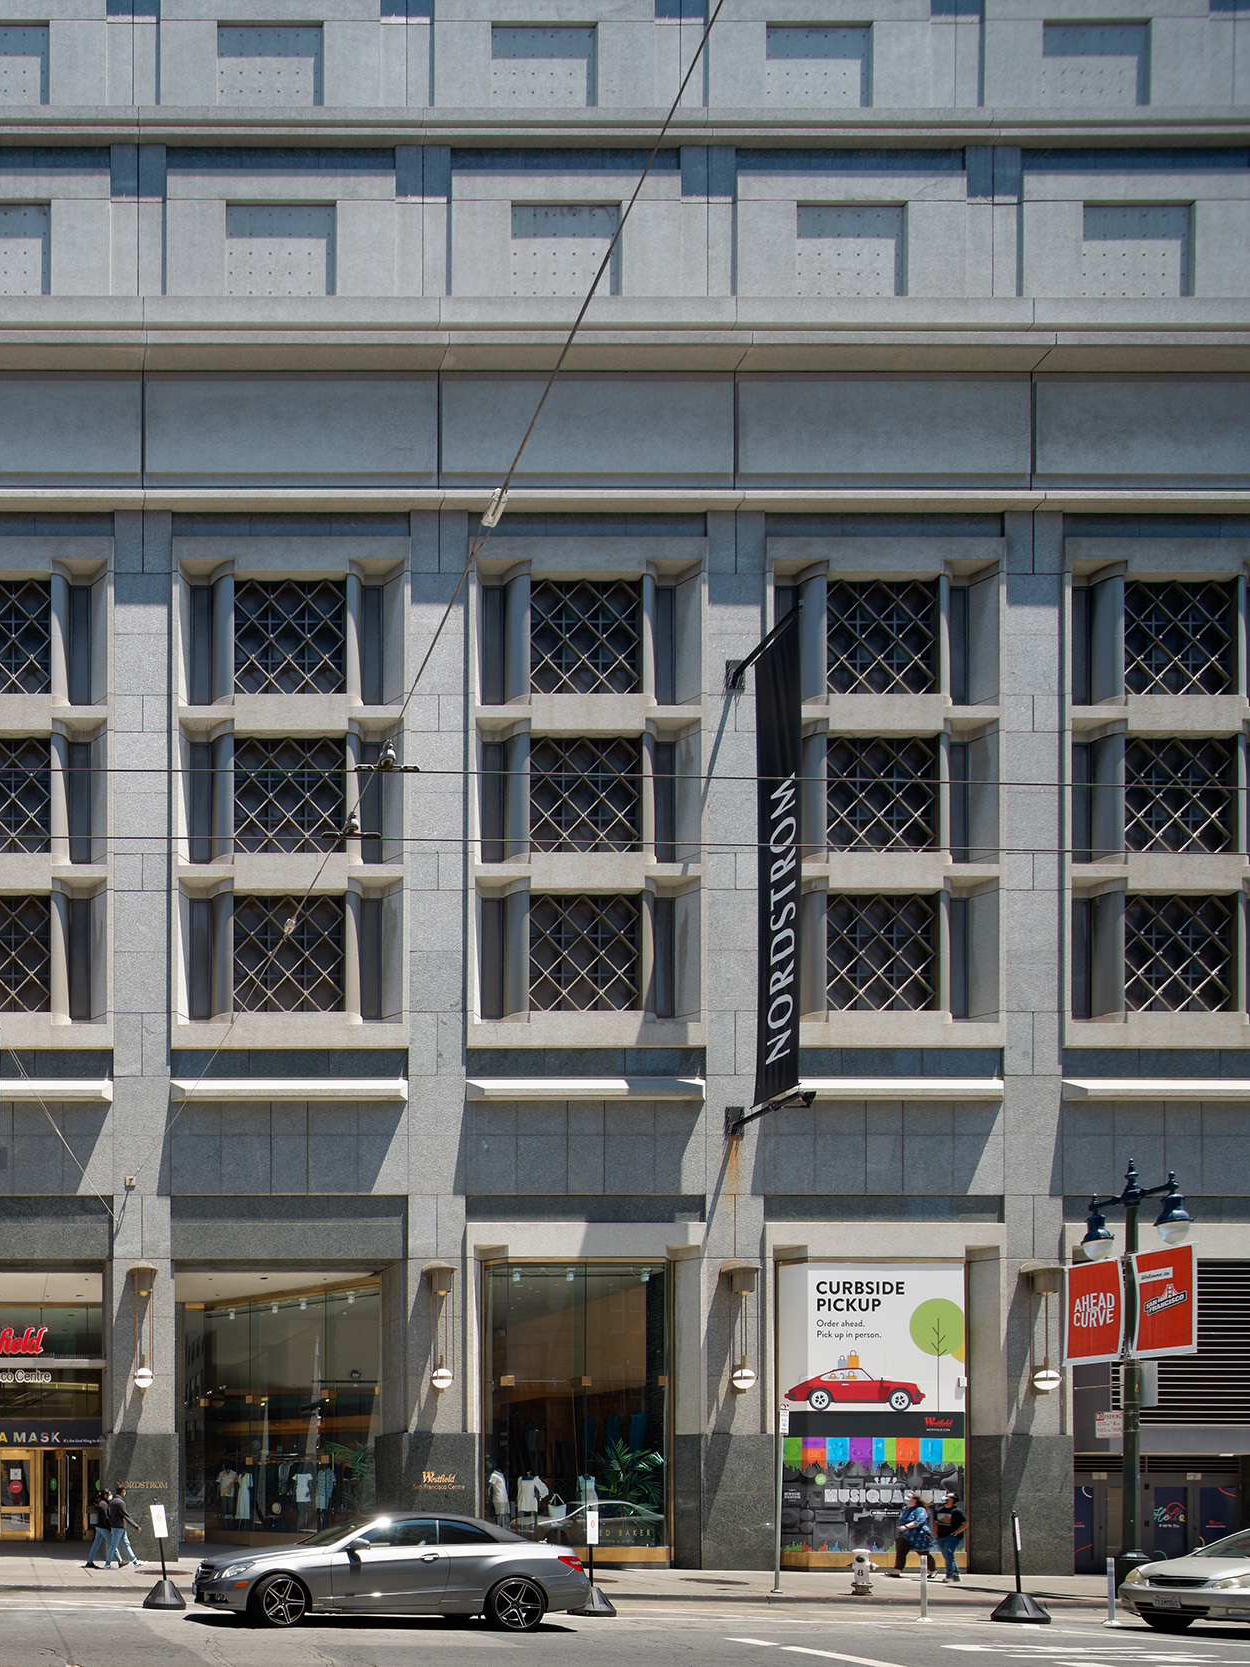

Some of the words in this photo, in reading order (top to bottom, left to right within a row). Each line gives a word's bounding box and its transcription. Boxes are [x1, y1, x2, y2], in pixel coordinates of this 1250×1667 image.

[765, 771, 797, 1066] NORDSTROM
[816, 1281, 905, 1295] CURBSIDE
[817, 1298, 882, 1312] PICKUP
[1074, 1292, 1115, 1313] AHEAD
[1146, 1300, 1158, 1309] SAN
[1149, 1294, 1185, 1313] FRANCISCO
[816, 1319, 839, 1327] Order
[1073, 1309, 1114, 1328] CURVE
[817, 1330, 832, 1338] Pick
[15, 1369, 52, 1382] Centre
[924, 1416, 954, 1427] Westfield
[13, 1432, 60, 1443] MASK
[422, 1471, 456, 1483] Westfield
